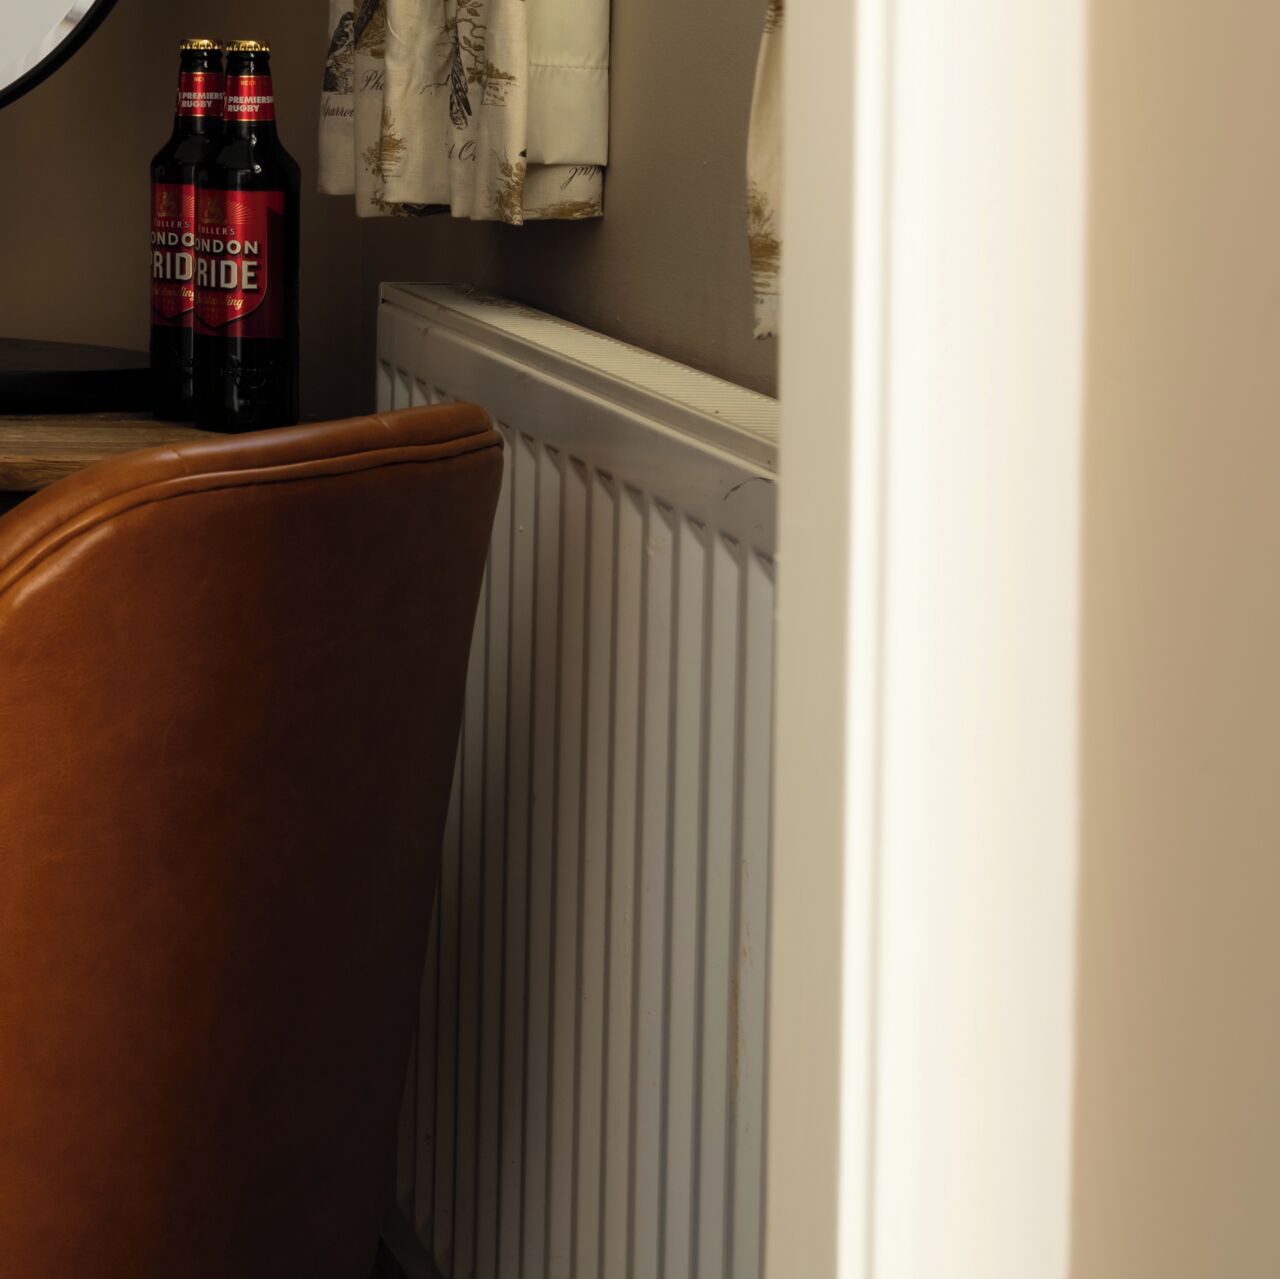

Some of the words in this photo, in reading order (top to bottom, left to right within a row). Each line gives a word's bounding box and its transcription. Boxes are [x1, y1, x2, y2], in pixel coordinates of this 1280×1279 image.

[181, 100, 213, 108] RUGBY
[227, 104, 260, 113] RUGBY
[152, 232, 195, 248] ONDO
[195, 239, 259, 255] ONDON
[151, 251, 193, 281] RID
[195, 257, 258, 290] RIDE
